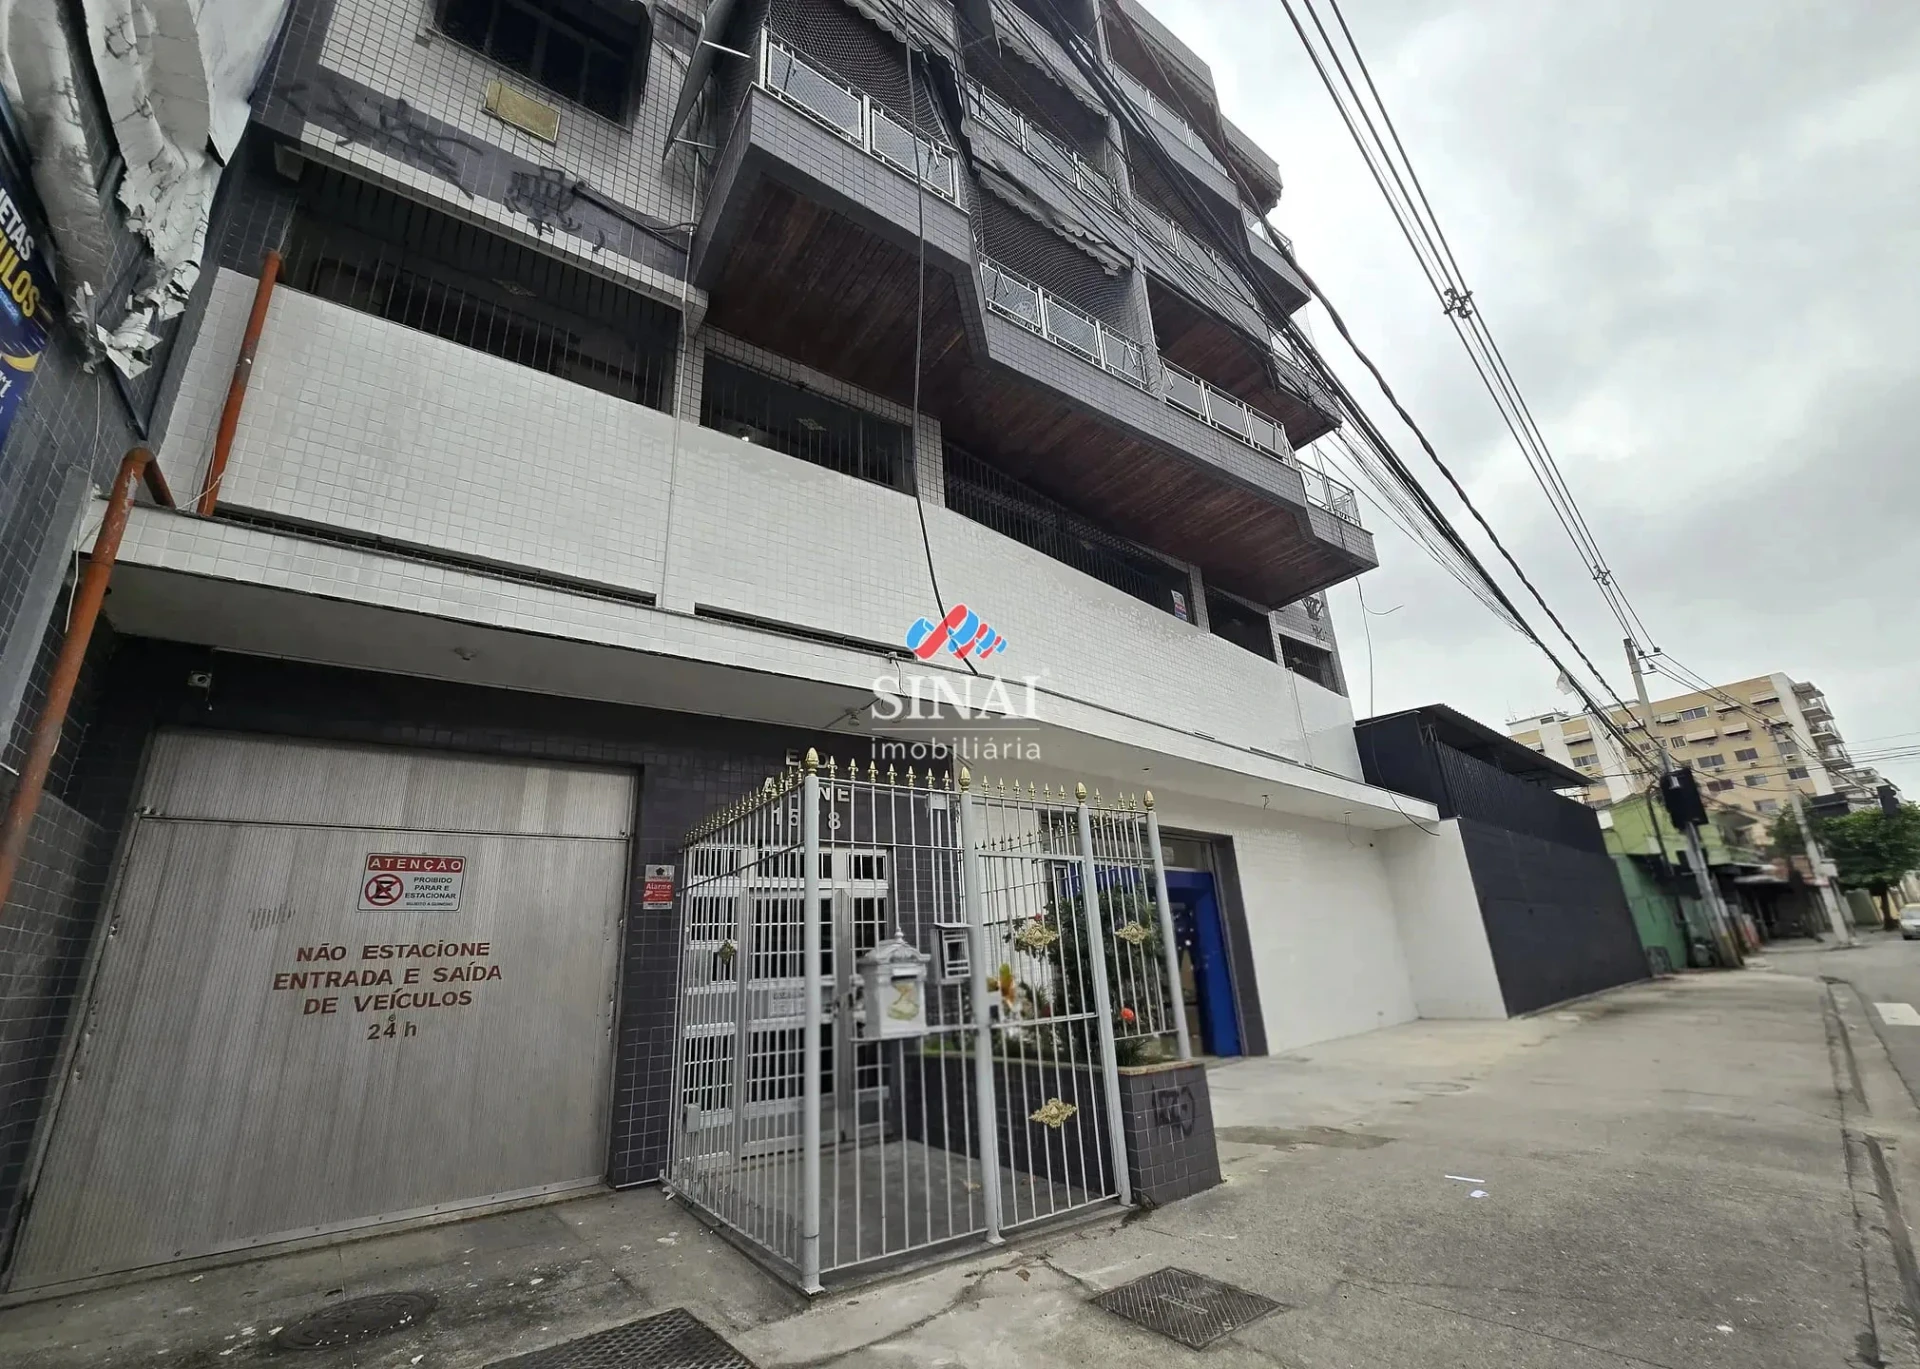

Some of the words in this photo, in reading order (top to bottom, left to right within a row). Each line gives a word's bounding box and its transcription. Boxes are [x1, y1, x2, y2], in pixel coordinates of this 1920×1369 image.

[0, 187, 35, 261] ETAS
[0, 227, 40, 317] ULOS
[370, 857, 461, 871] ATENÇÃO
[413, 876, 453, 884] PROIBIDO
[296, 943, 347, 961] NÃO
[273, 969, 393, 990] ENTRADA
[403, 968, 420, 984] E
[433, 962, 502, 982] SAÍDA
[303, 996, 339, 1015] DE
[354, 988, 472, 1012] VEÍCULOS
[367, 1021, 396, 1040] 24
